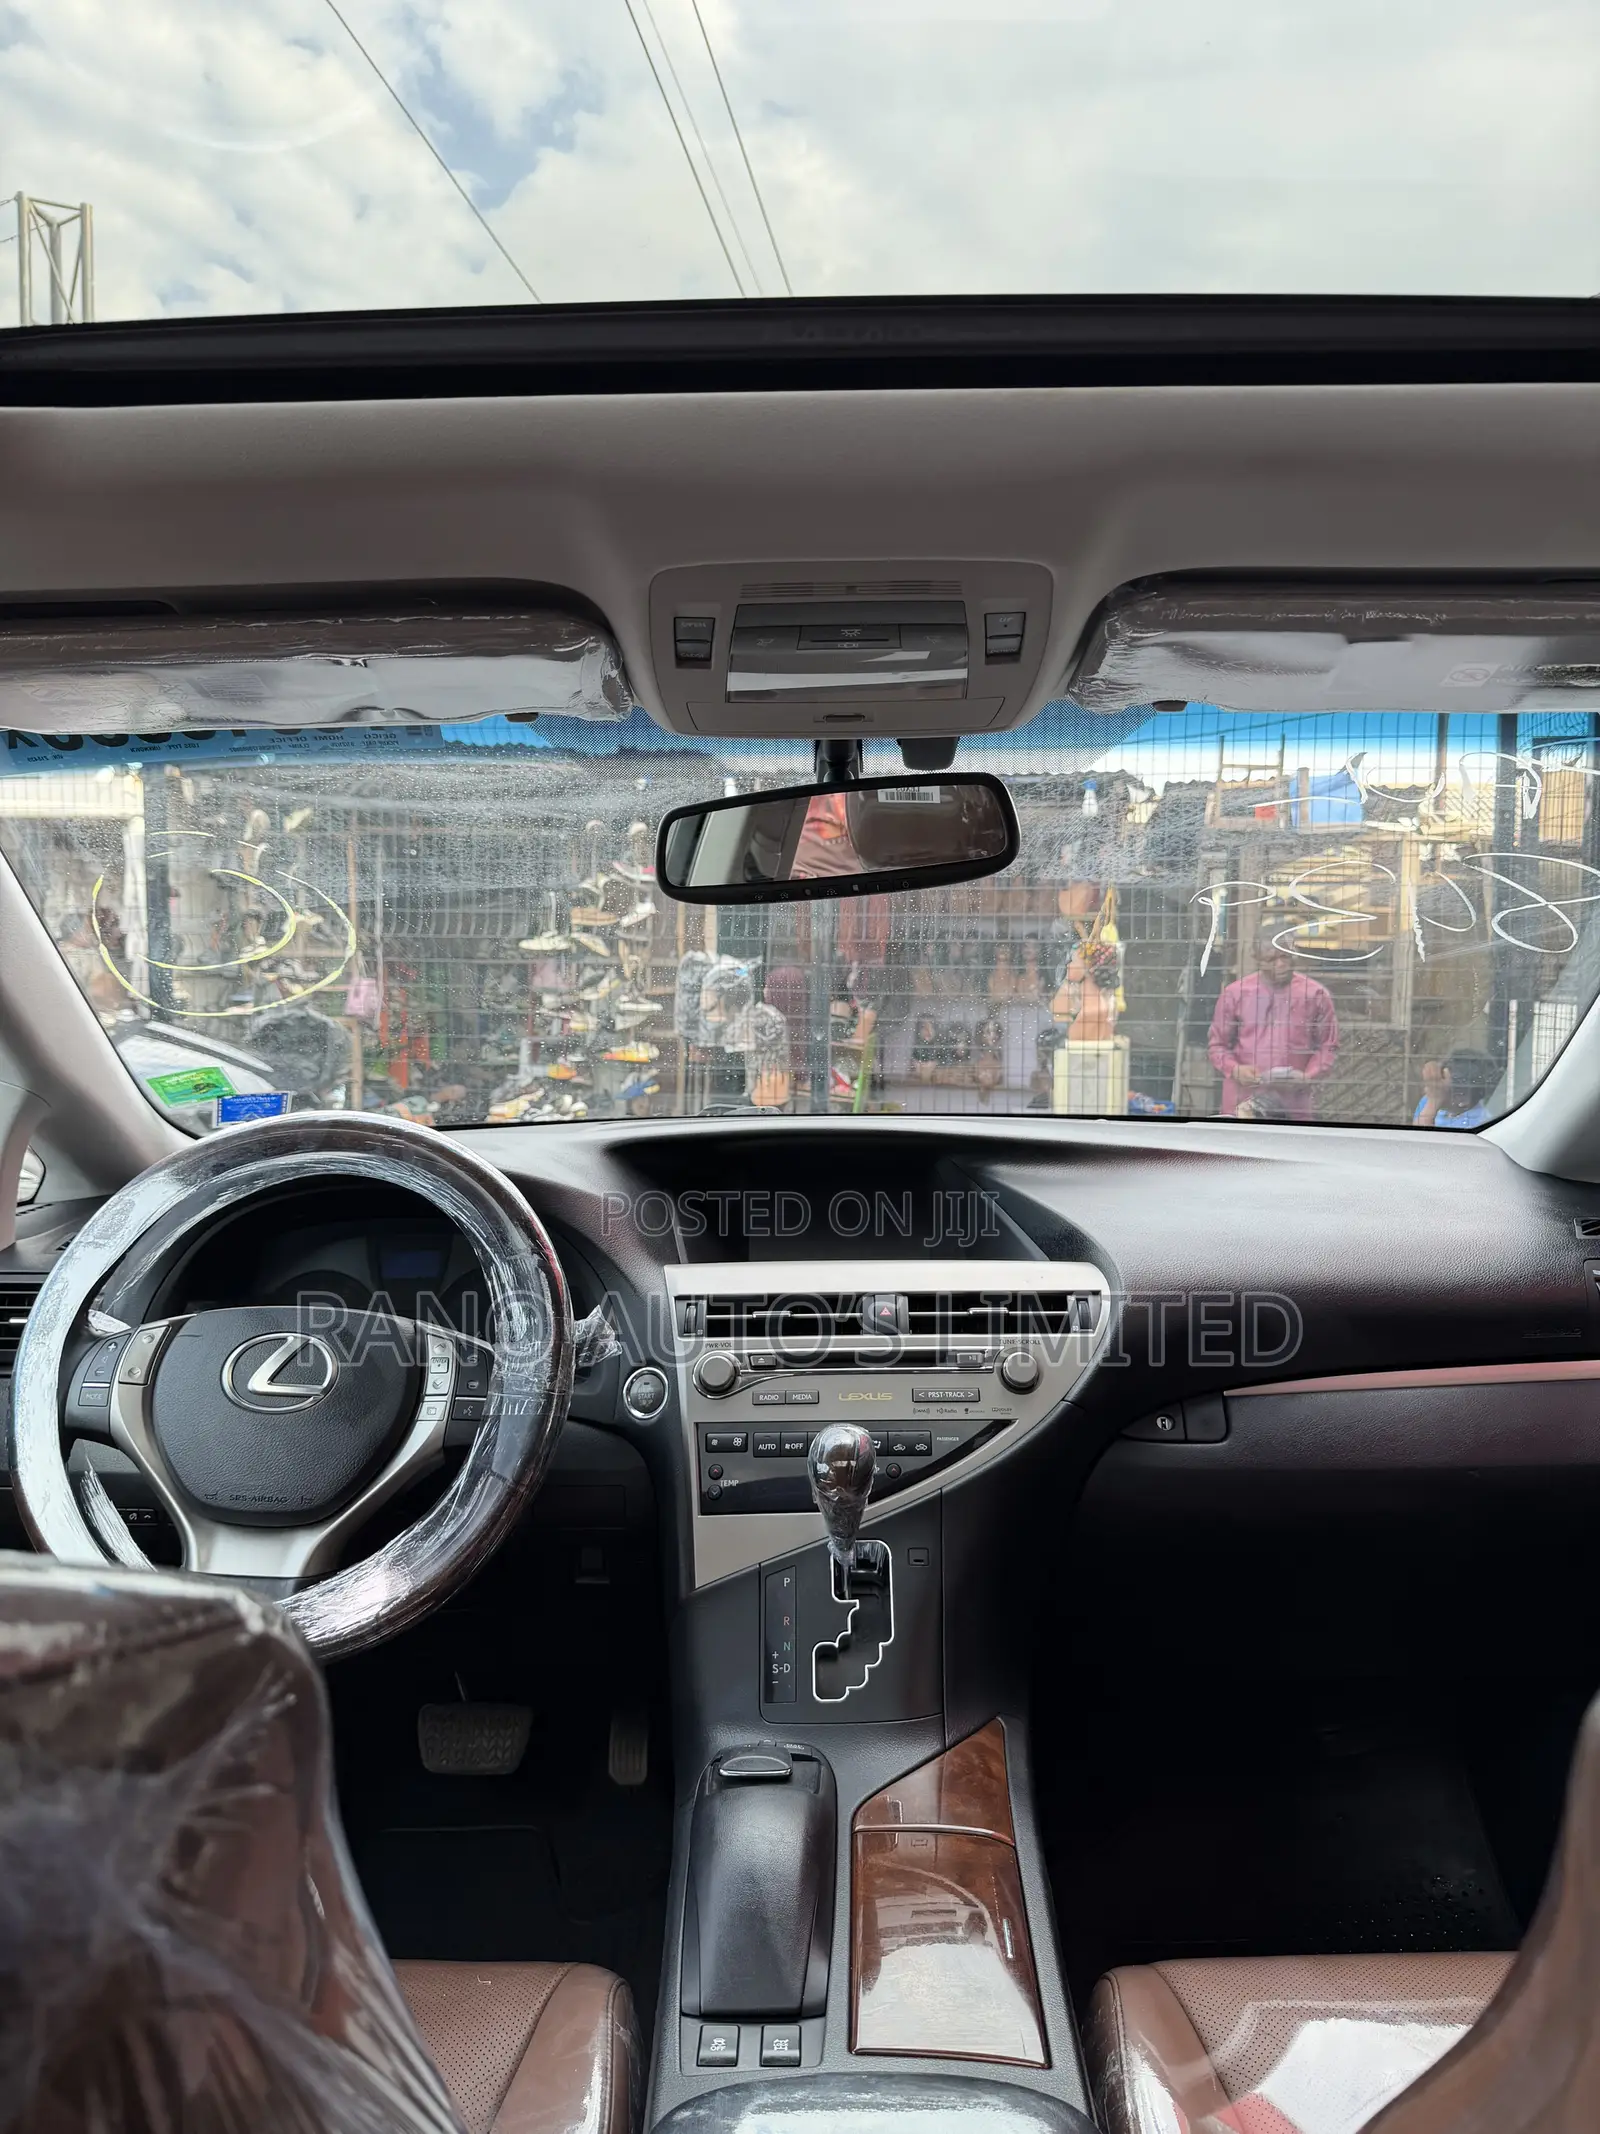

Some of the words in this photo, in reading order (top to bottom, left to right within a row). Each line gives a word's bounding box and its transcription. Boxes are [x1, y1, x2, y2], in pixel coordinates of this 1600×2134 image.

[792, 1393, 813, 1401] MEDIA
[838, 1392, 893, 1401] LEXUS
[757, 1443, 777, 1451] AUTO
[790, 1442, 804, 1450] OFF
[720, 1480, 740, 1488] TEMP
[783, 1578, 791, 1588] P
[783, 1616, 790, 1626] R
[783, 1642, 791, 1652] N
[710, 2044, 727, 2052] OFF
